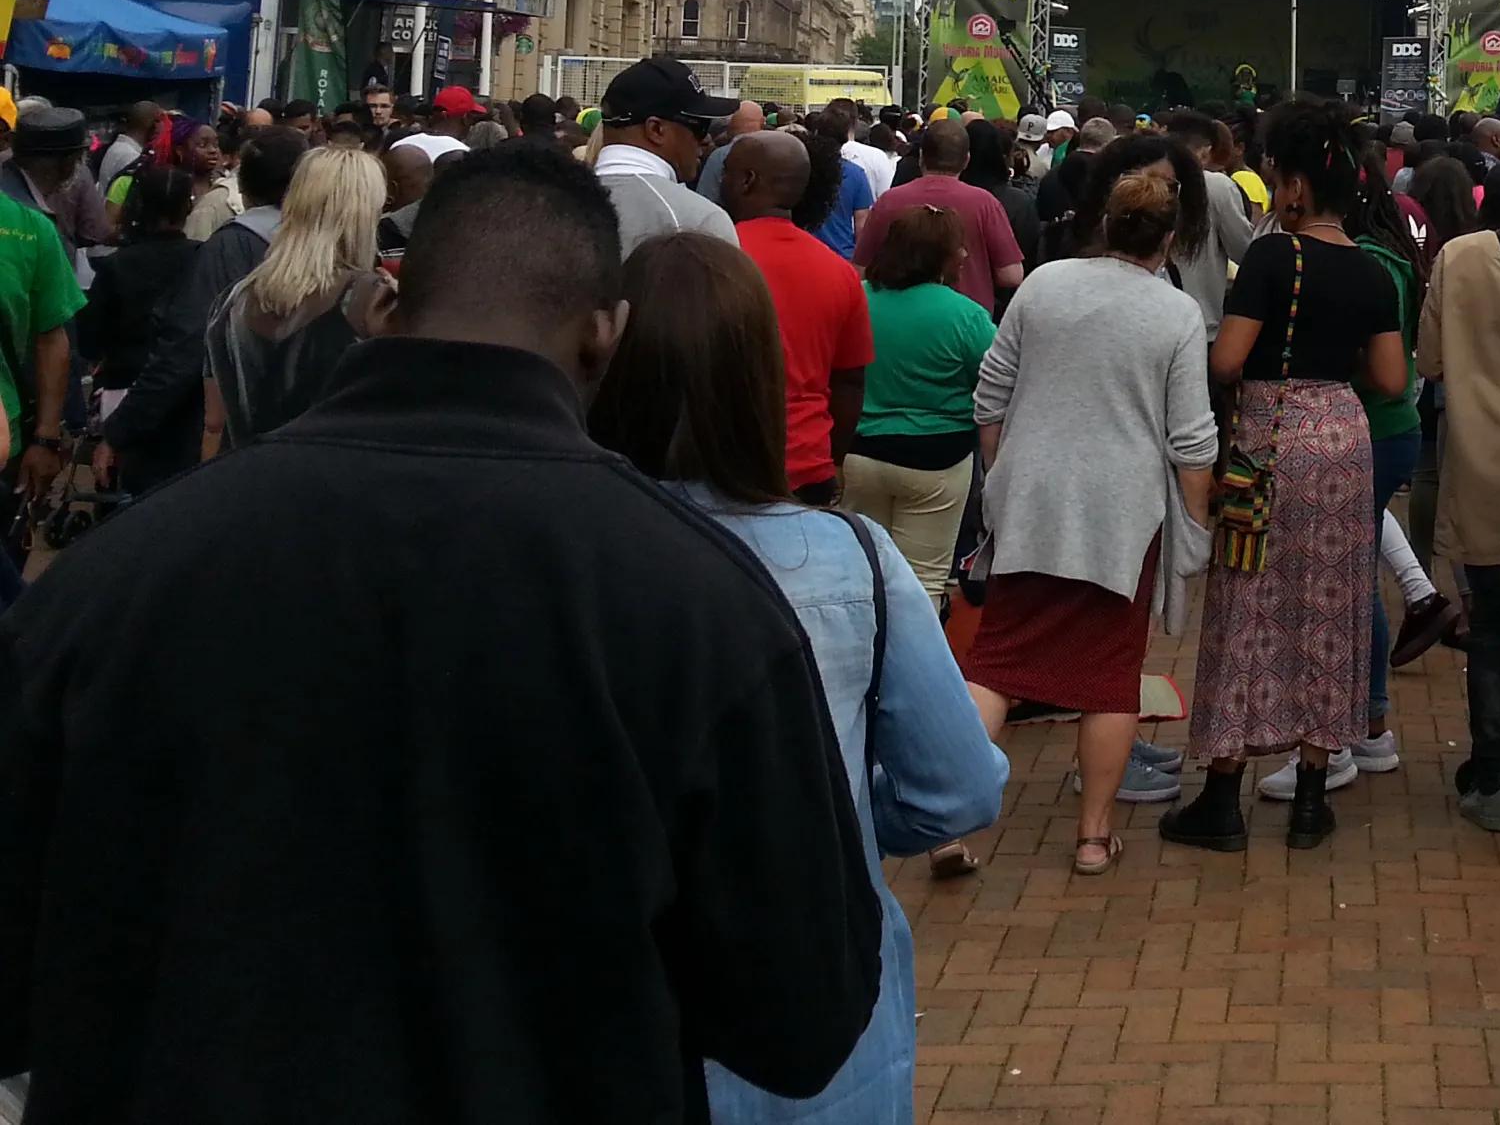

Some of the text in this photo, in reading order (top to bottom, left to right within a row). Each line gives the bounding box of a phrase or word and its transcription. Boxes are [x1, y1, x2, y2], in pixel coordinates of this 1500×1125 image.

[1053, 33, 1079, 48] DDC
[1392, 43, 1422, 57] DDC
[316, 69, 329, 118] ROYAL
